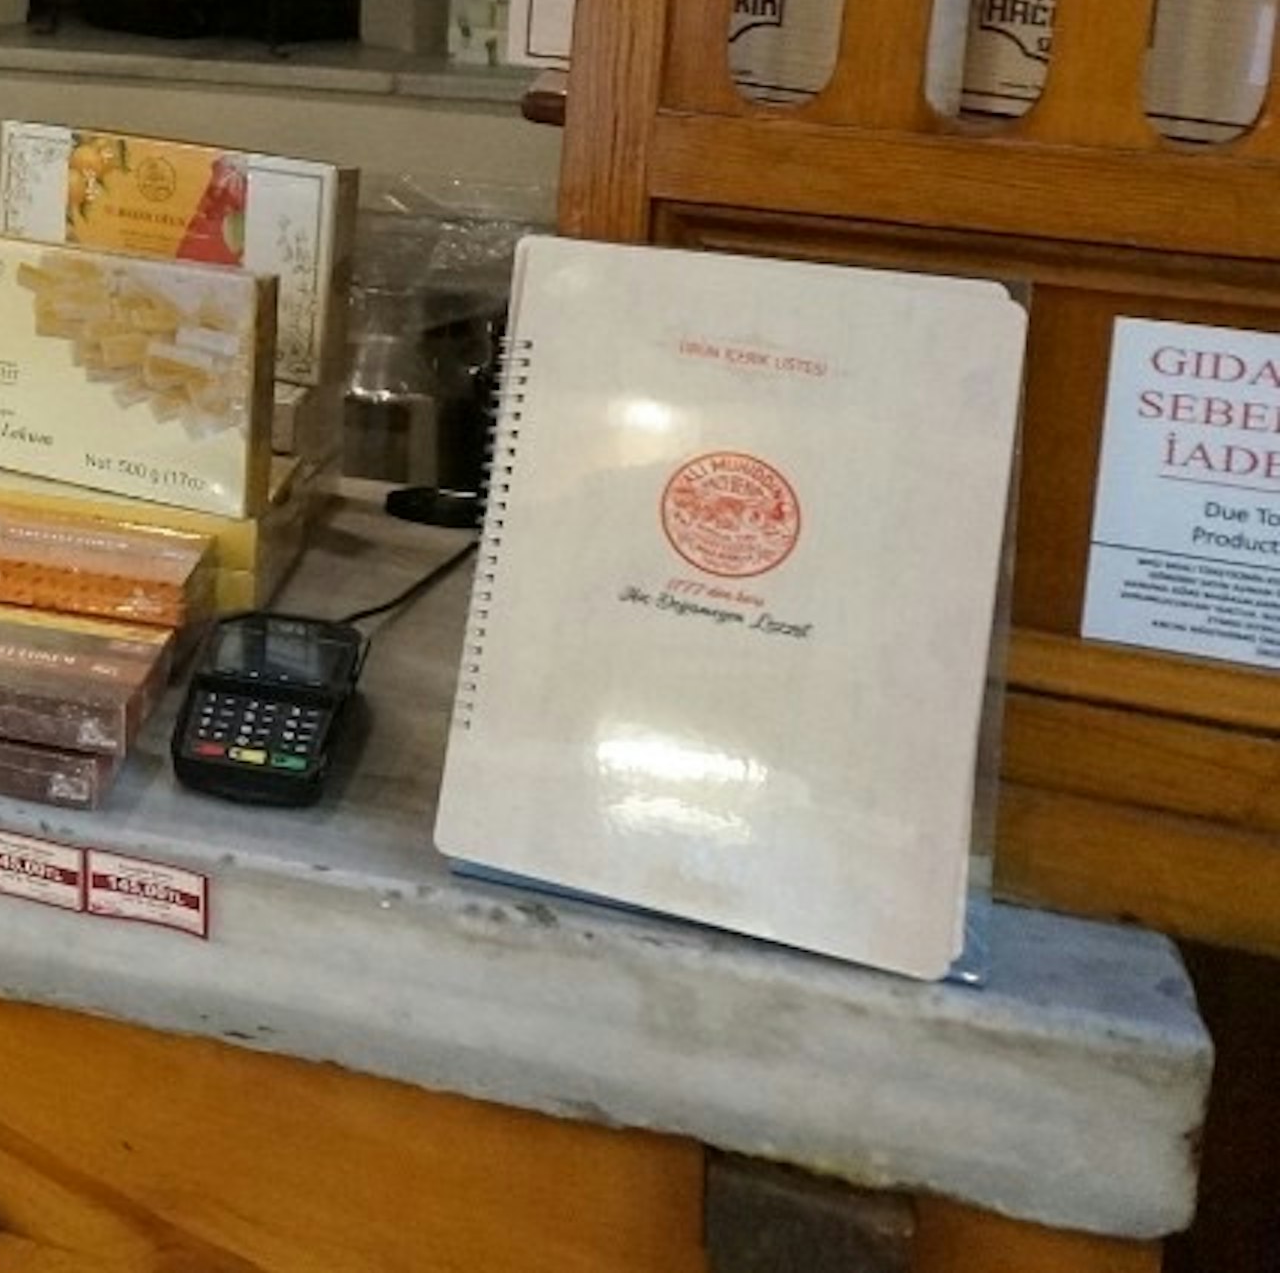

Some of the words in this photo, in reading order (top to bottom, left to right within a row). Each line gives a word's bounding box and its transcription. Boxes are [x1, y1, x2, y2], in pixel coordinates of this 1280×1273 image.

[1151, 345, 1280, 388] GIDA
[1138, 390, 1280, 433] SEBE
[1204, 501, 1248, 523] Due
